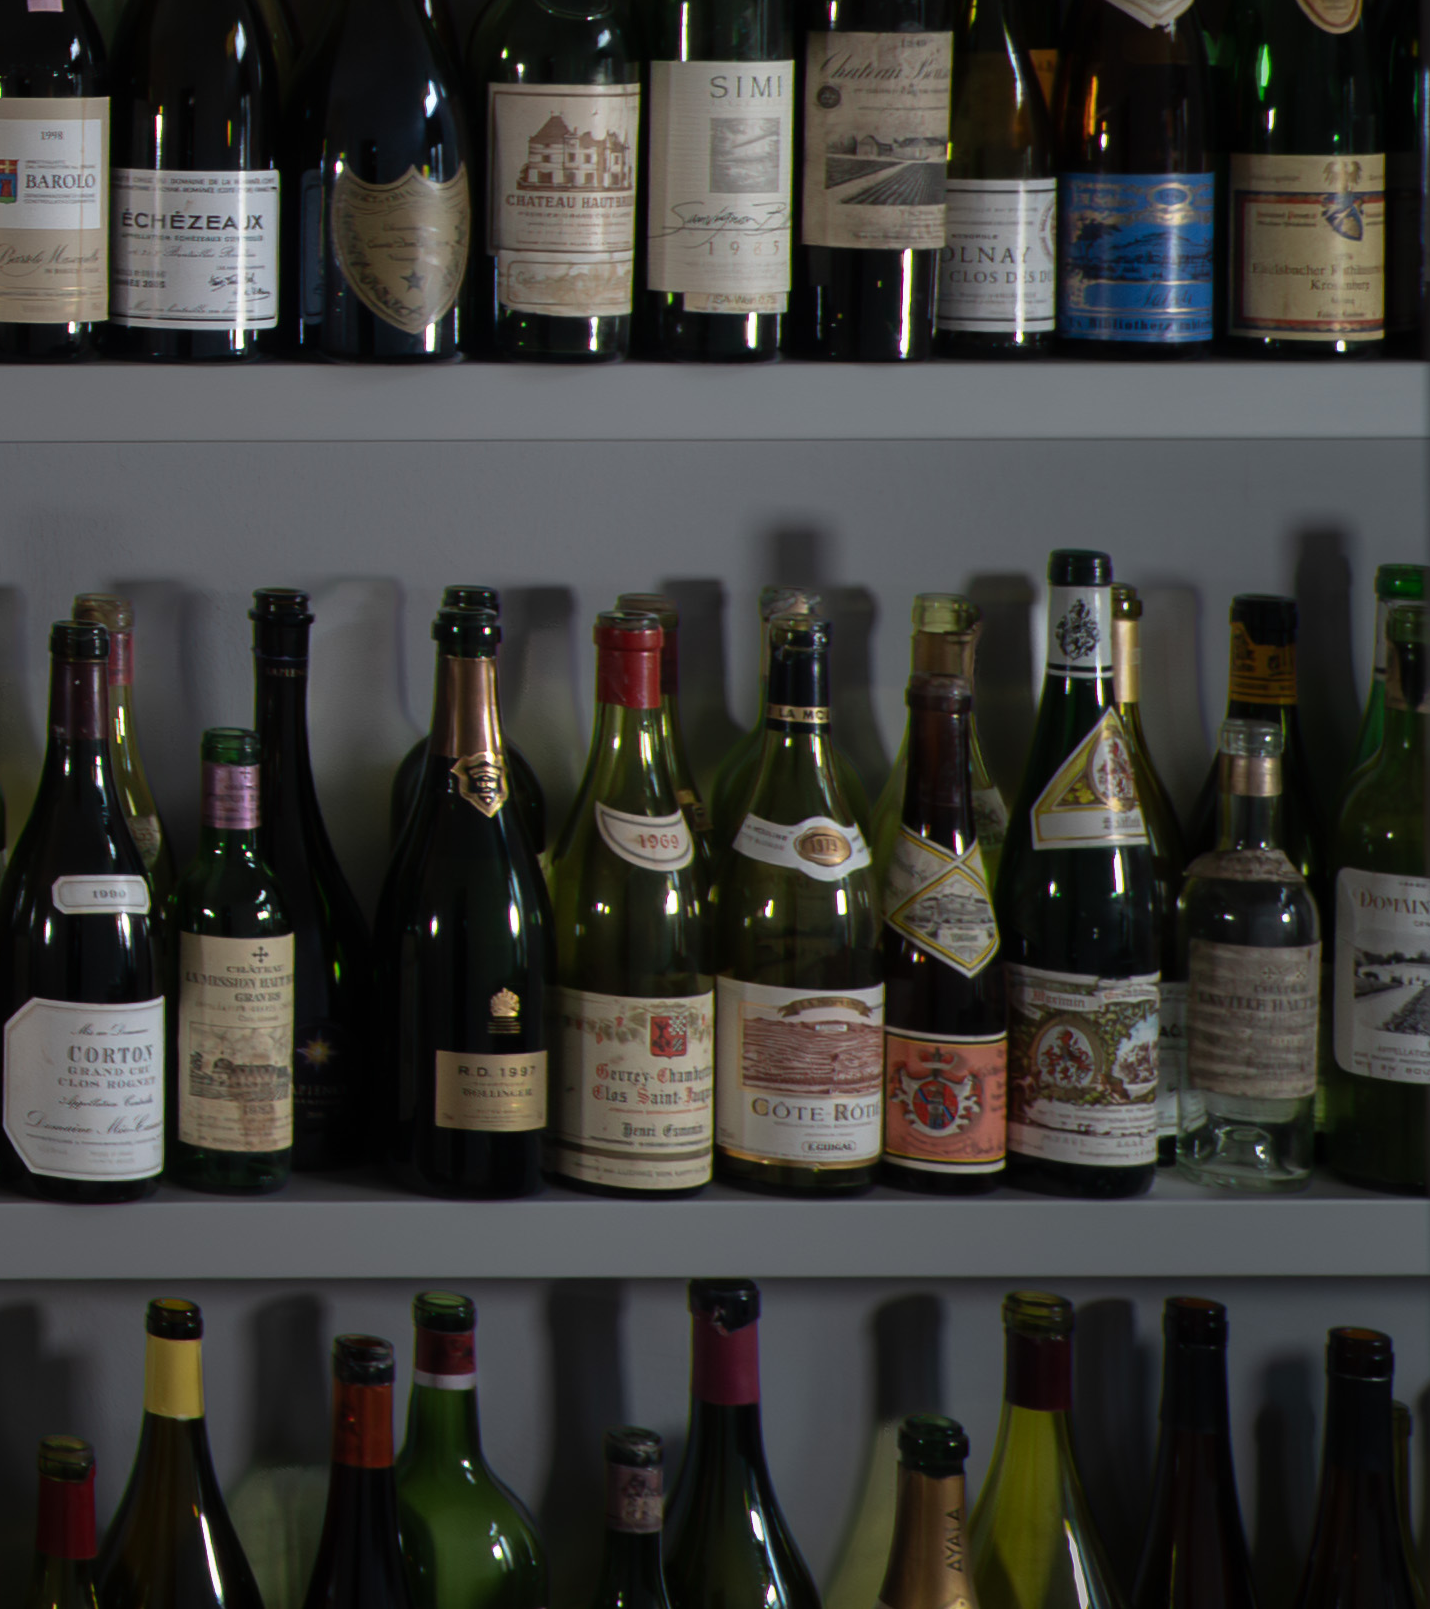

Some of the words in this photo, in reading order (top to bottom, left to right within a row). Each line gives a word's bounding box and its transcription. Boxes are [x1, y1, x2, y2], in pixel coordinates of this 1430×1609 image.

[709, 75, 783, 100] SIMI
[24, 171, 97, 190] BAROLO
[505, 194, 579, 208] CHATEAU
[121, 206, 263, 231] ÉCHÉZEAUX
[68, 1044, 153, 1064] CORTON
[498, 1065, 537, 1077] 1997
